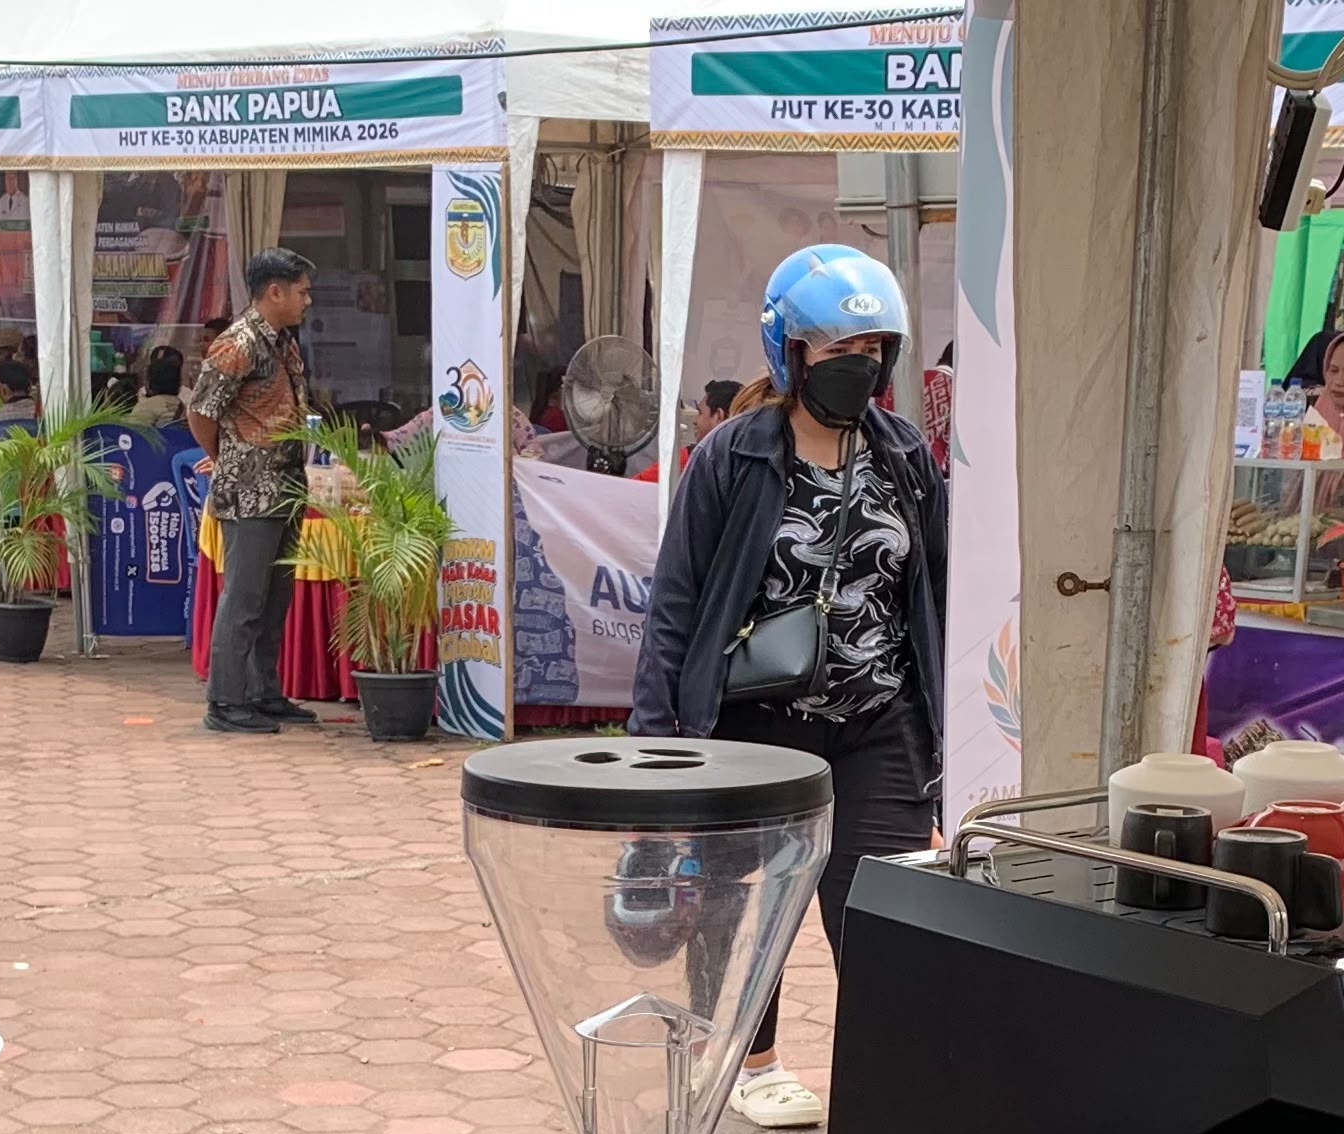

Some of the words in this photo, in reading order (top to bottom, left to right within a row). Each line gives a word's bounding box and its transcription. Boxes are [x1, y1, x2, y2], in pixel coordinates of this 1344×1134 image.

[869, 23, 952, 47] MENUJU
[166, 93, 241, 123] BANK
[247, 89, 342, 121] PAPUA
[771, 100, 817, 119] HUT
[824, 100, 894, 120] KE-30
[119, 130, 147, 147] HUT
[152, 129, 194, 146] KE-30
[198, 128, 290, 146] KABUPATEN
[294, 125, 353, 143] MIMIKA
[357, 122, 399, 141] 2026
[441, 602, 501, 637] PASAR
